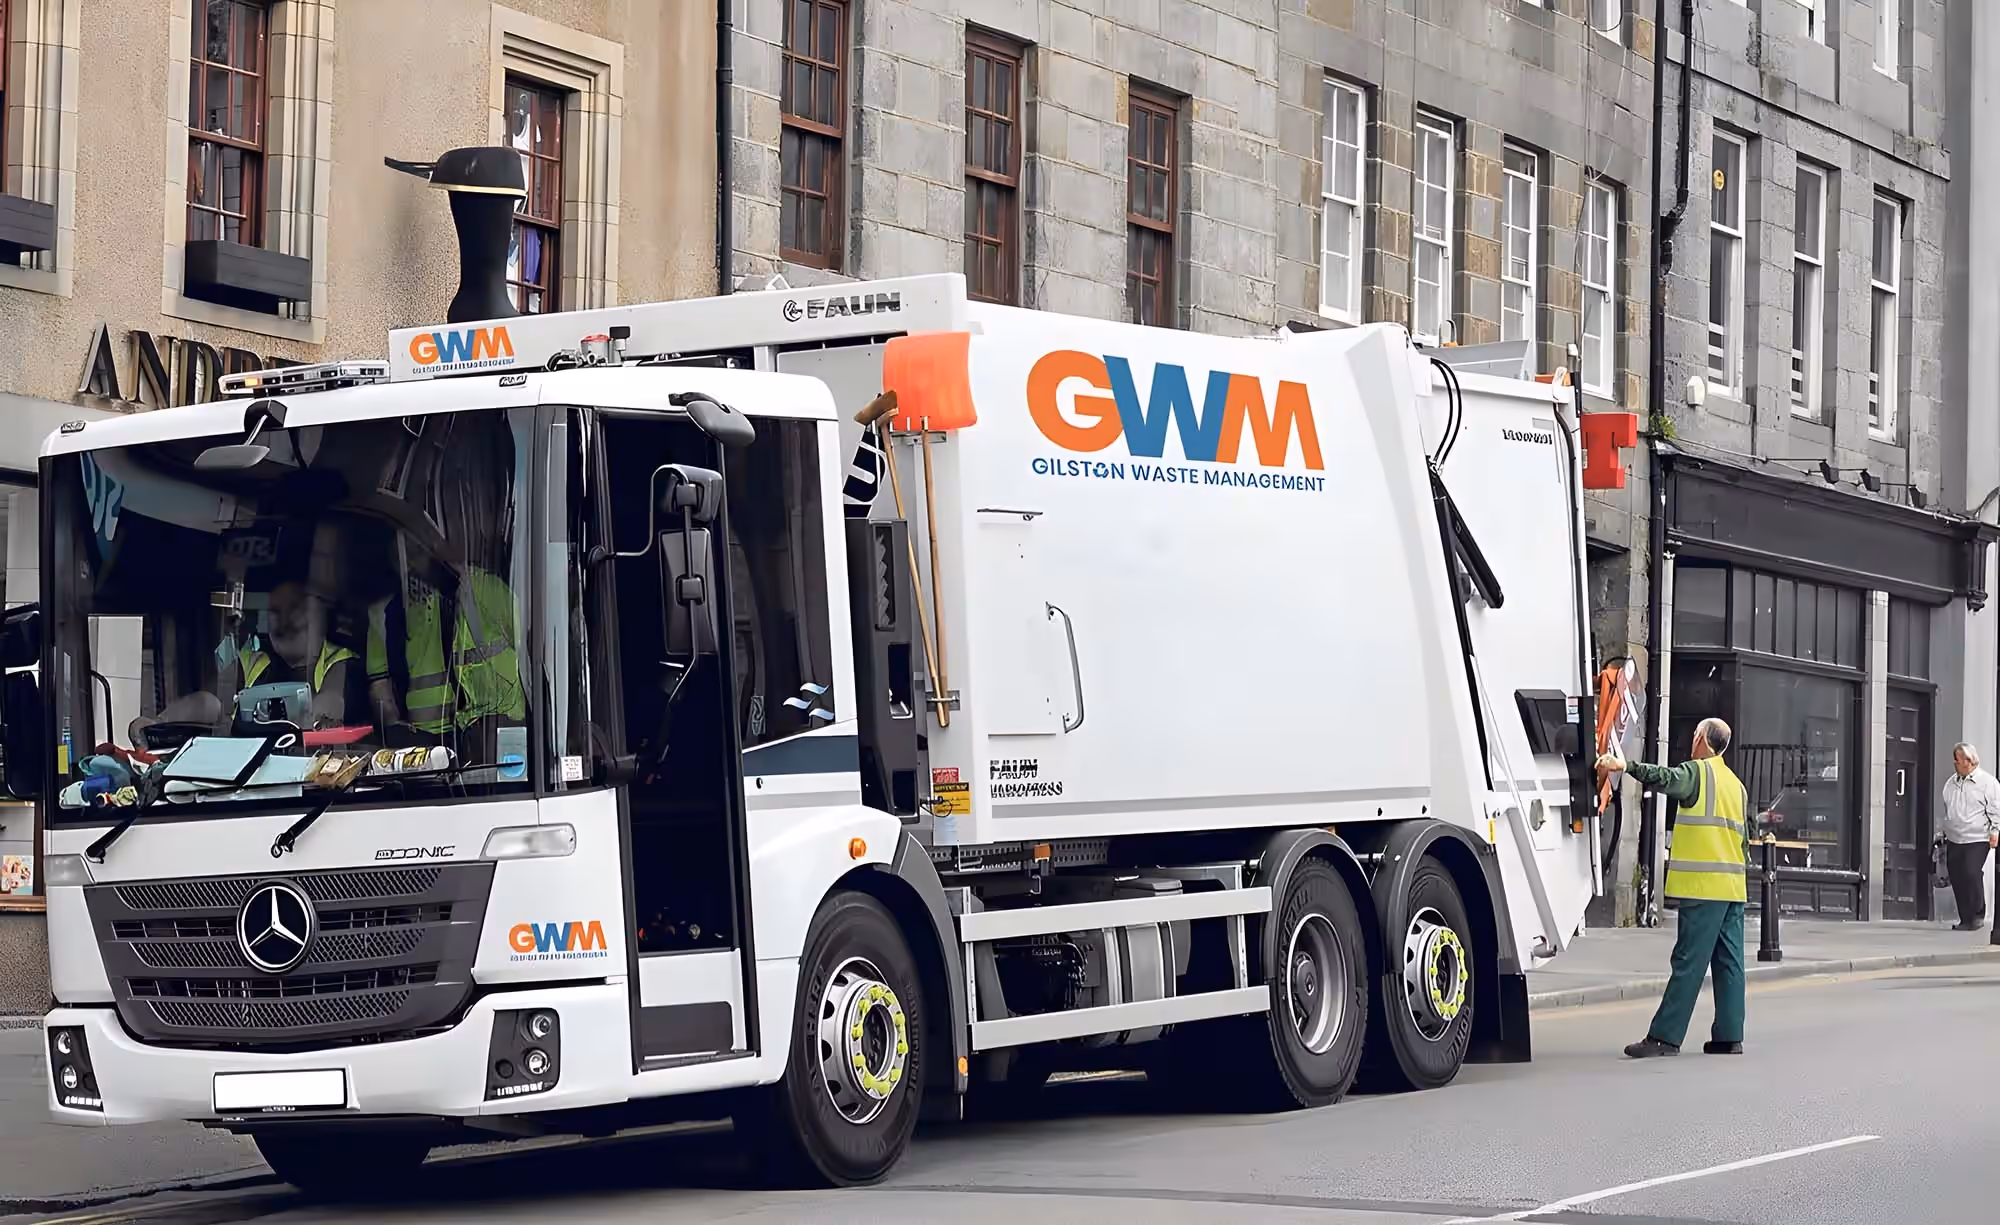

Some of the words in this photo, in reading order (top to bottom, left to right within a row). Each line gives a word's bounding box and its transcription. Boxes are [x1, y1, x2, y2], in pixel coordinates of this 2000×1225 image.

[807, 292, 900, 319] FAUN
[409, 325, 515, 365] GWM
[1026, 349, 1325, 471] GWM
[1032, 457, 1124, 480] GILSTON
[1131, 464, 1199, 485] WASTE
[1204, 469, 1325, 492] MANAGEMENT
[508, 920, 608, 953] GWM
